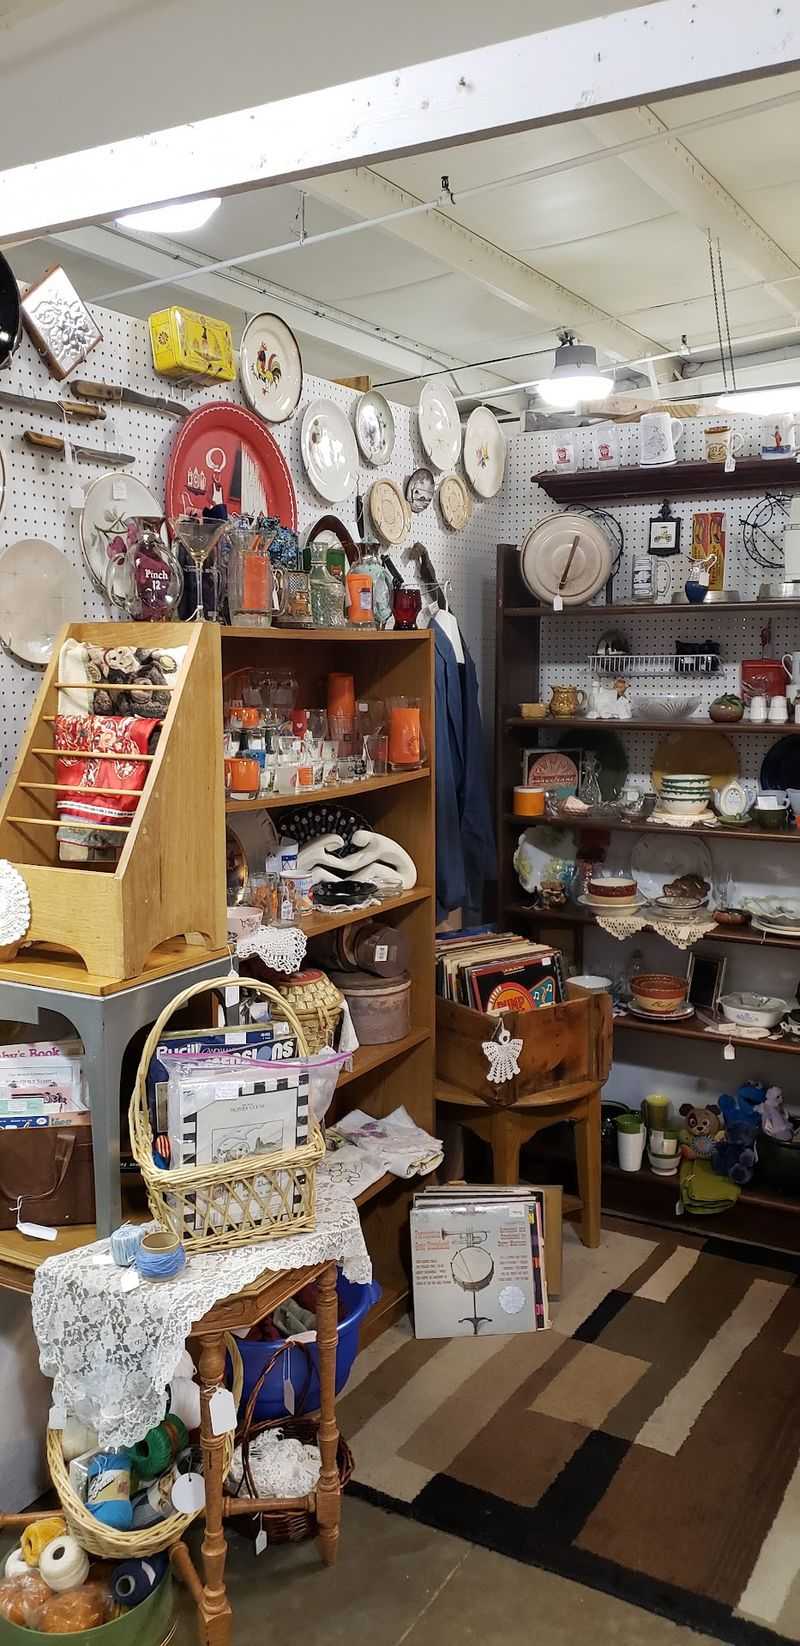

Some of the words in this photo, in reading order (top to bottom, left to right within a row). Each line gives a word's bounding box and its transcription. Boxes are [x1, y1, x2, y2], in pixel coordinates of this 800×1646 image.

[145, 568, 168, 580] Pinch
[152, 579, 161, 590] 12
[29, 1047, 60, 1057] Book
